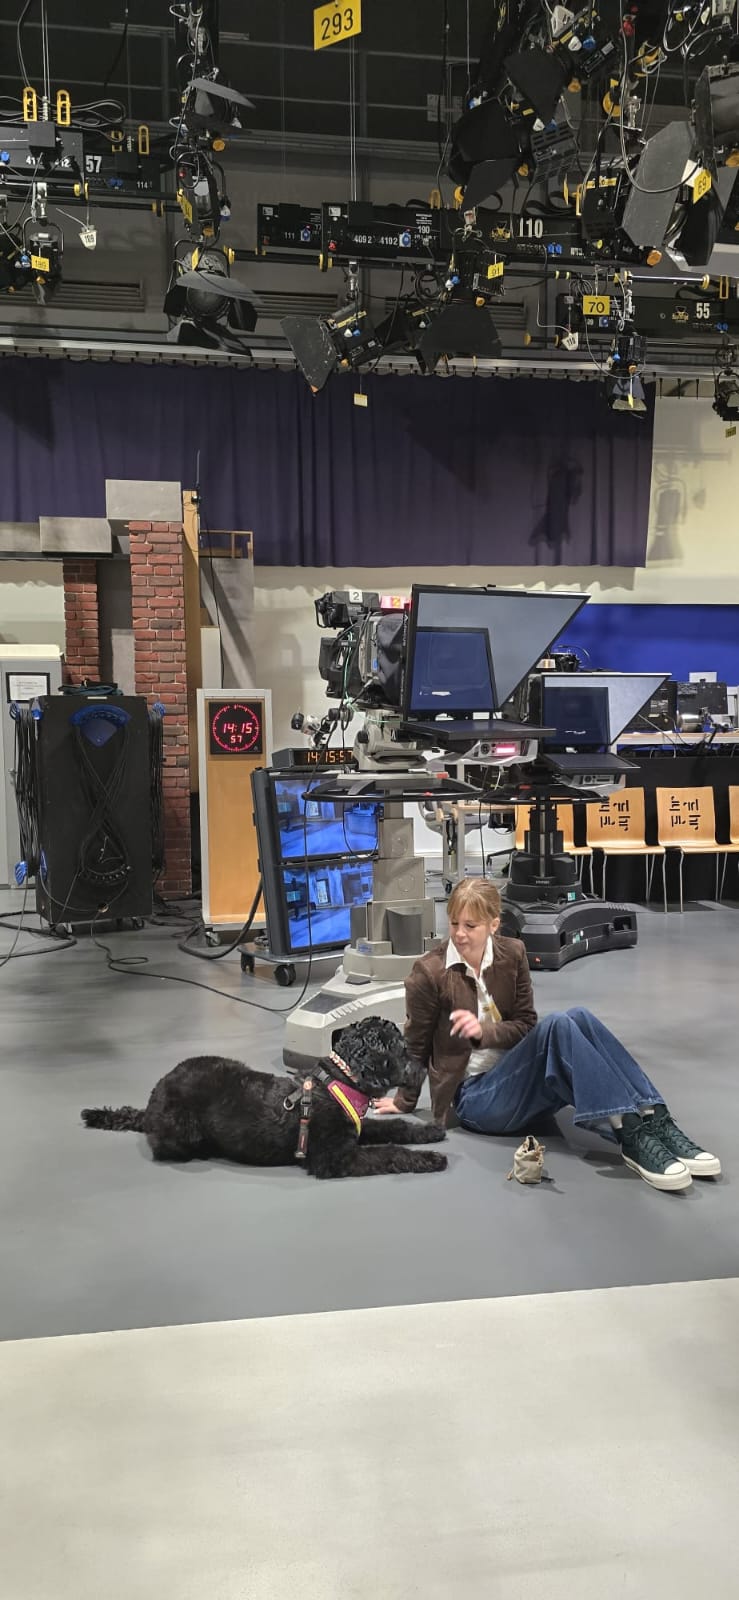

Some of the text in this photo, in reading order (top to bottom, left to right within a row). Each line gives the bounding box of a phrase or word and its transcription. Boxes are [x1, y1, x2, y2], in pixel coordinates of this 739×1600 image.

[321, 8, 353, 41] 293
[85, 155, 102, 173] 57
[417, 225, 430, 234] 190
[519, 217, 543, 238] 110
[588, 302, 605, 313] 70
[695, 302, 710, 319] 55
[353, 591, 360, 600] 2
[230, 735, 243, 744] 57
